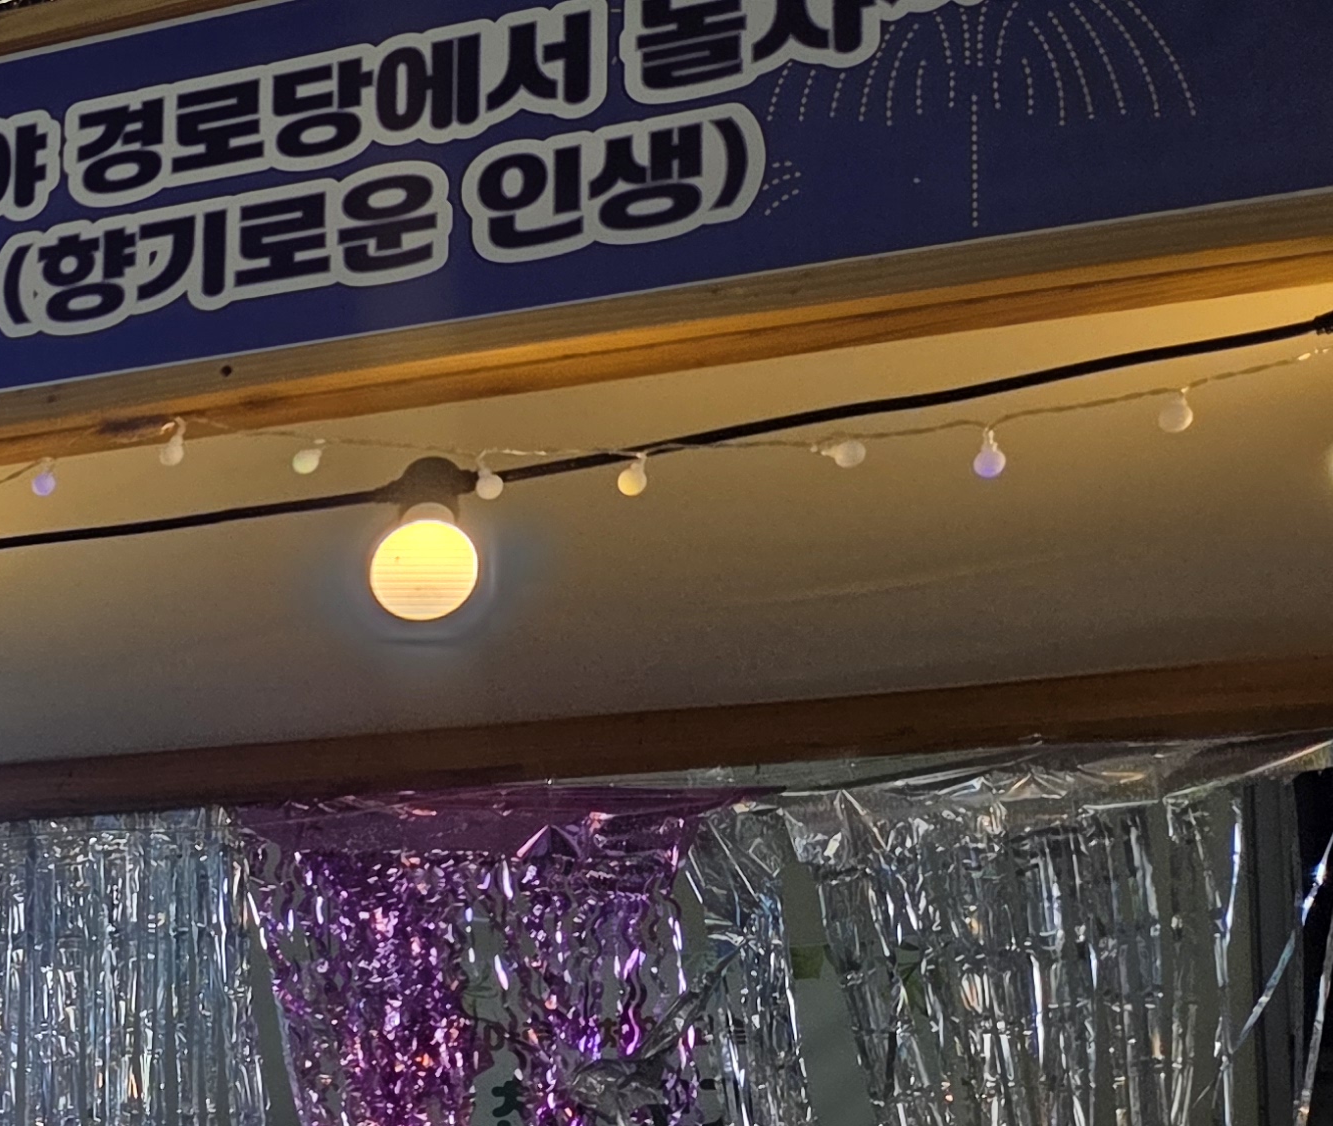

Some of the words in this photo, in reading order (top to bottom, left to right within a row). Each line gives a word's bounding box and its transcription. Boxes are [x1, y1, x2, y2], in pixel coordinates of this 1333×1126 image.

[77, 8, 593, 194] 경로당에서
[3, 173, 439, 325] (향기로운
[477, 115, 750, 251] 인생)
